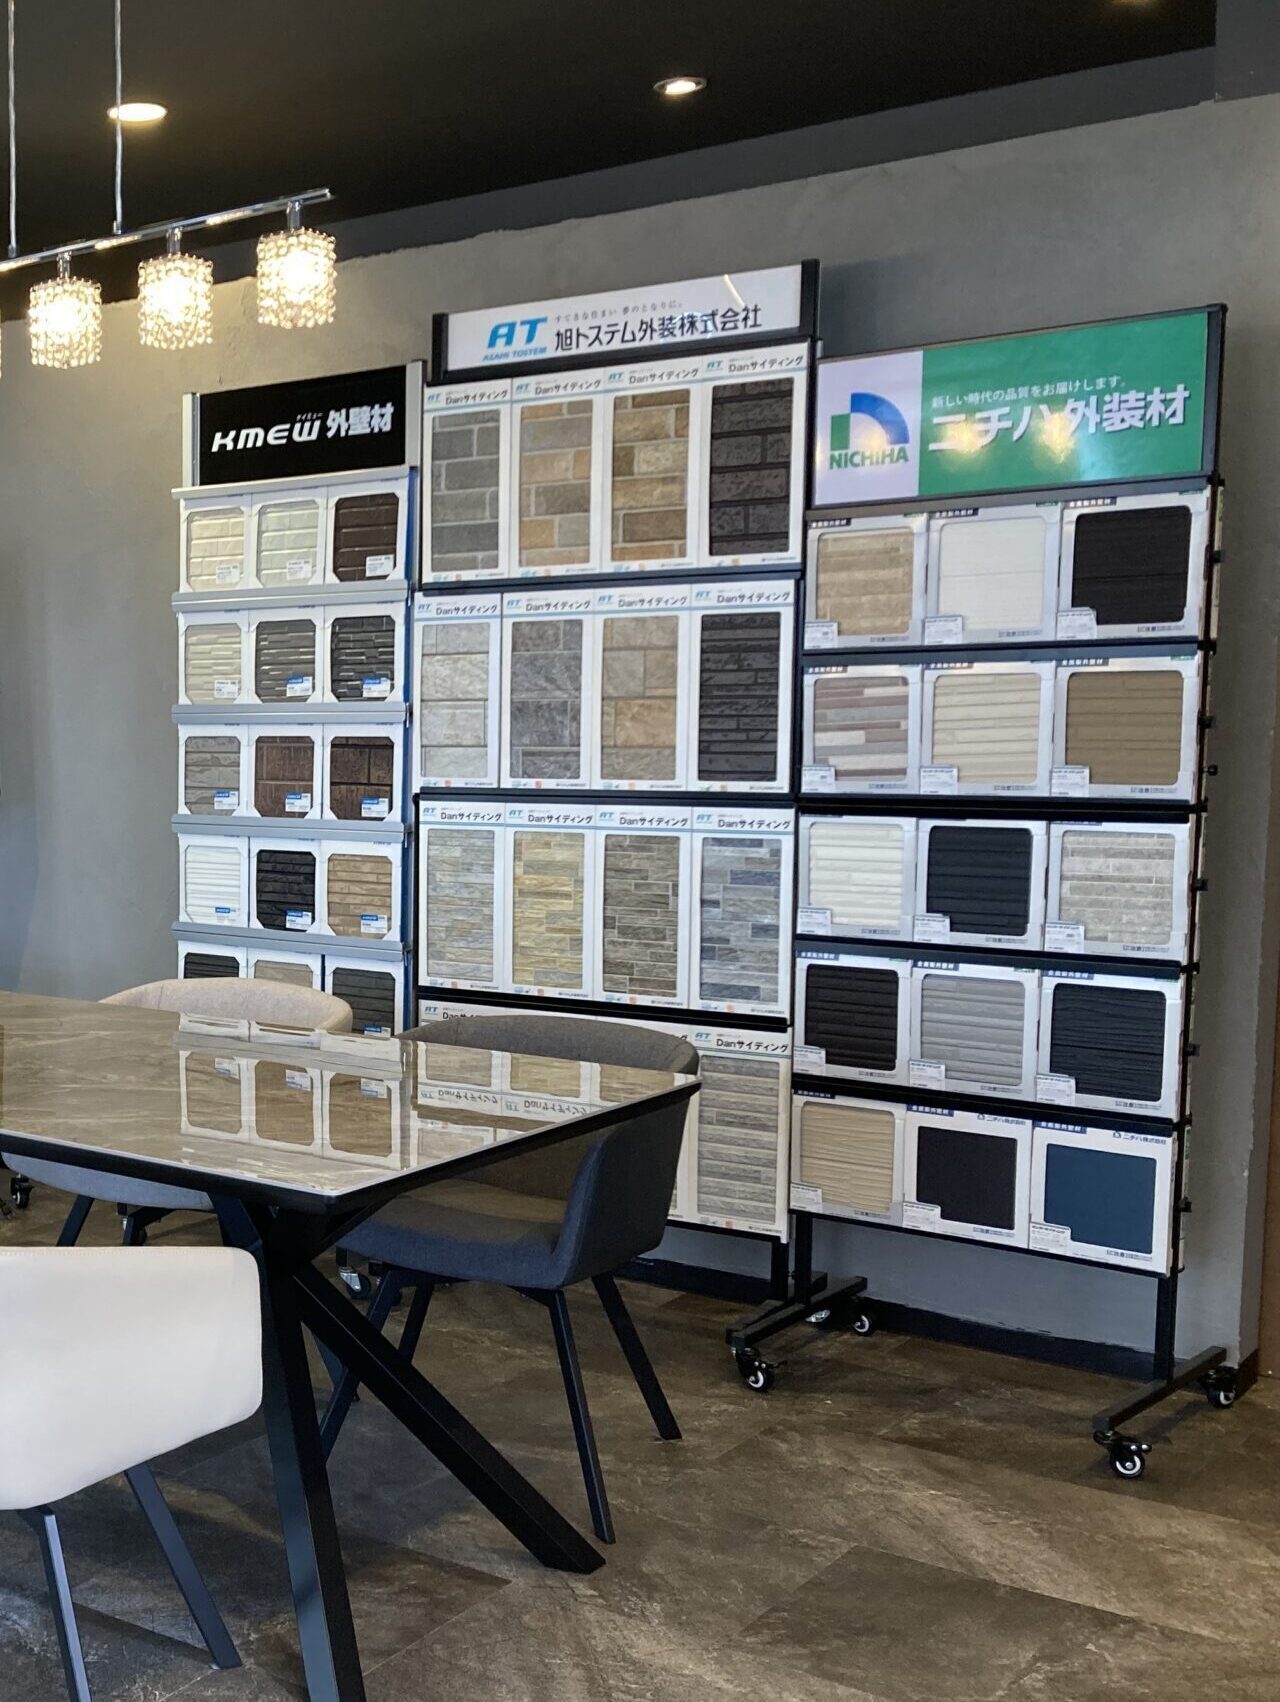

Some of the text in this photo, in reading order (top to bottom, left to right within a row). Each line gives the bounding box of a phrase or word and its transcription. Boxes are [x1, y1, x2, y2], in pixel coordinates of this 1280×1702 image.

[554, 305, 762, 352] 旭トステム外装株式会社
[931, 375, 1126, 409] 新しい時代の品質をお届けします。
[326, 402, 394, 438] 外壁材
[829, 446, 909, 470] NICHIHA
[440, 811, 502, 822] Danサイディング
[528, 813, 593, 824] Danサイディング
[619, 816, 688, 828] Danサイディング
[718, 817, 791, 829] Danサイディング
[715, 1038, 789, 1053] Danサイディング
